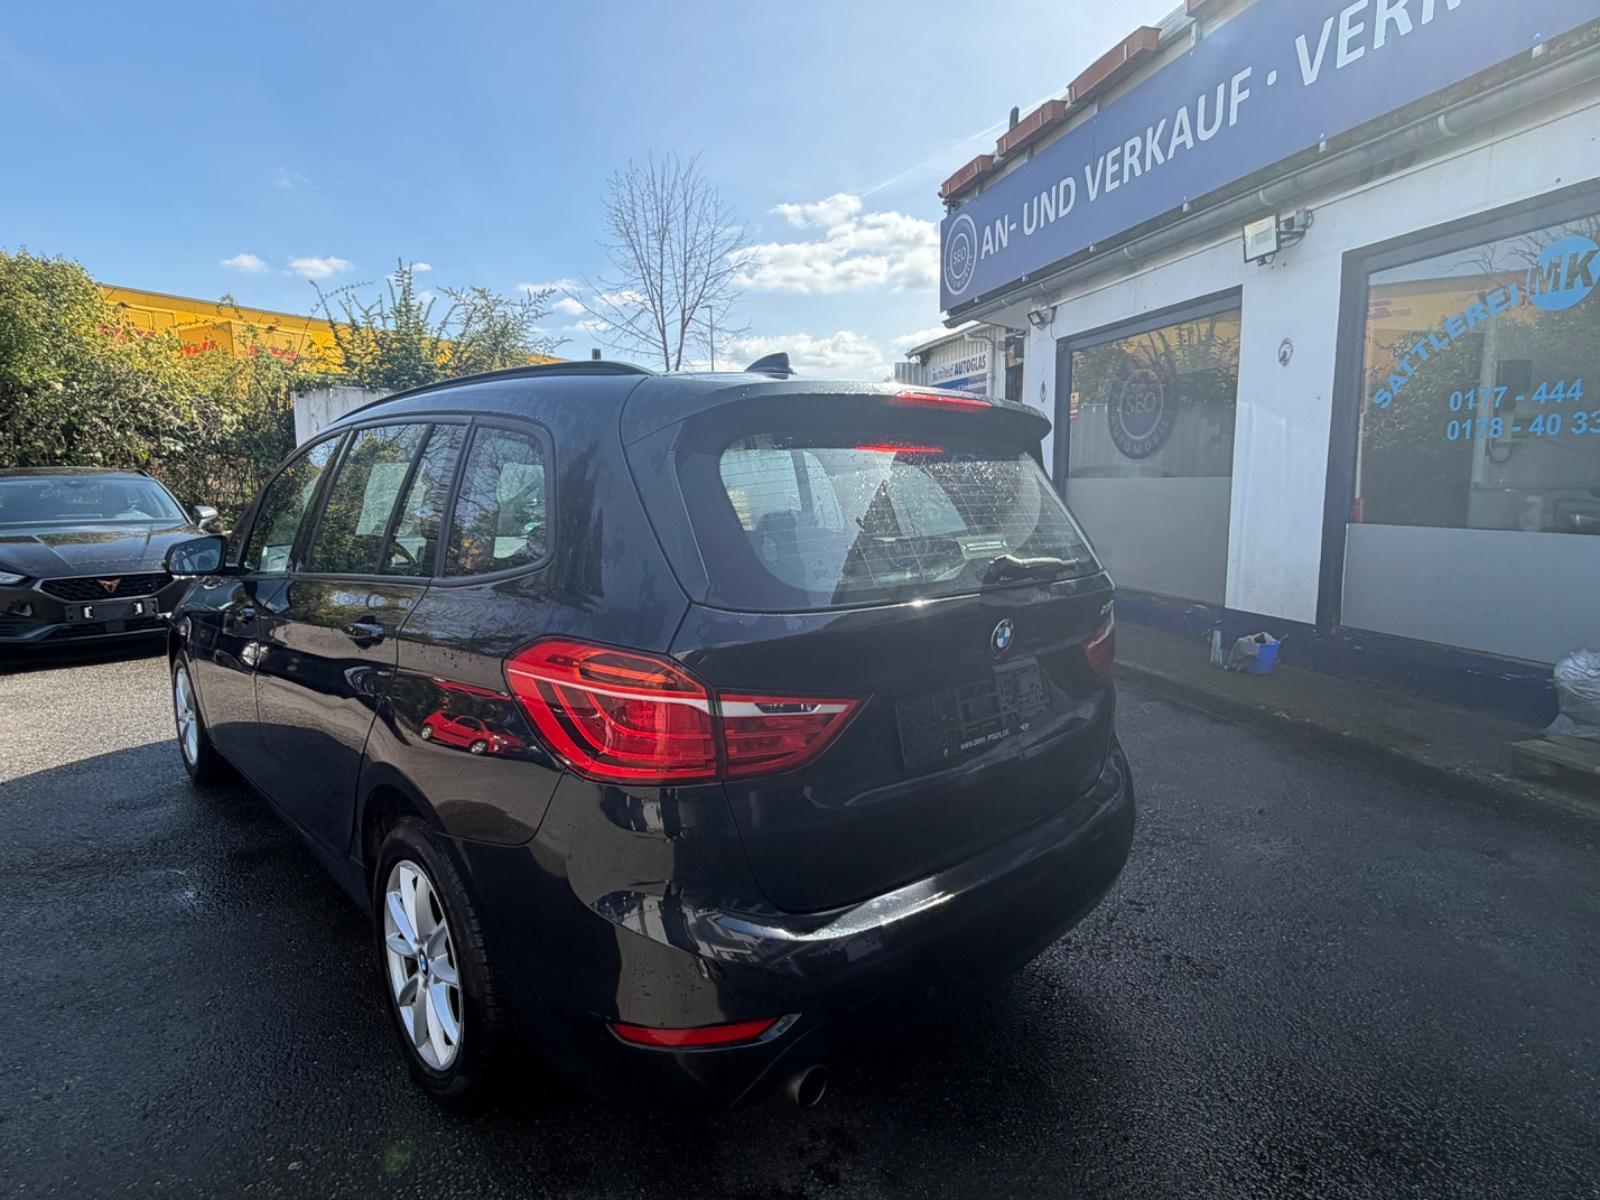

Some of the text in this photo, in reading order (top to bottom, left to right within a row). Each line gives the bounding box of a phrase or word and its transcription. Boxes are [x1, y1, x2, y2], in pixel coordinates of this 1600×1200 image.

[981, 213, 1017, 259] AN-
[1023, 176, 1076, 235] UND
[1085, 66, 1252, 202] VERKAUF
[1295, 0, 1461, 87] VER
[1532, 249, 1599, 295] MK
[1374, 282, 1521, 410] SATTLEREI
[954, 354, 986, 376] AUTOGLAS
[1125, 391, 1156, 415] SEO
[1449, 386, 1508, 412] 0177
[1532, 378, 1584, 404] 444
[1446, 417, 1504, 441] 0178
[1528, 412, 1562, 437] 40
